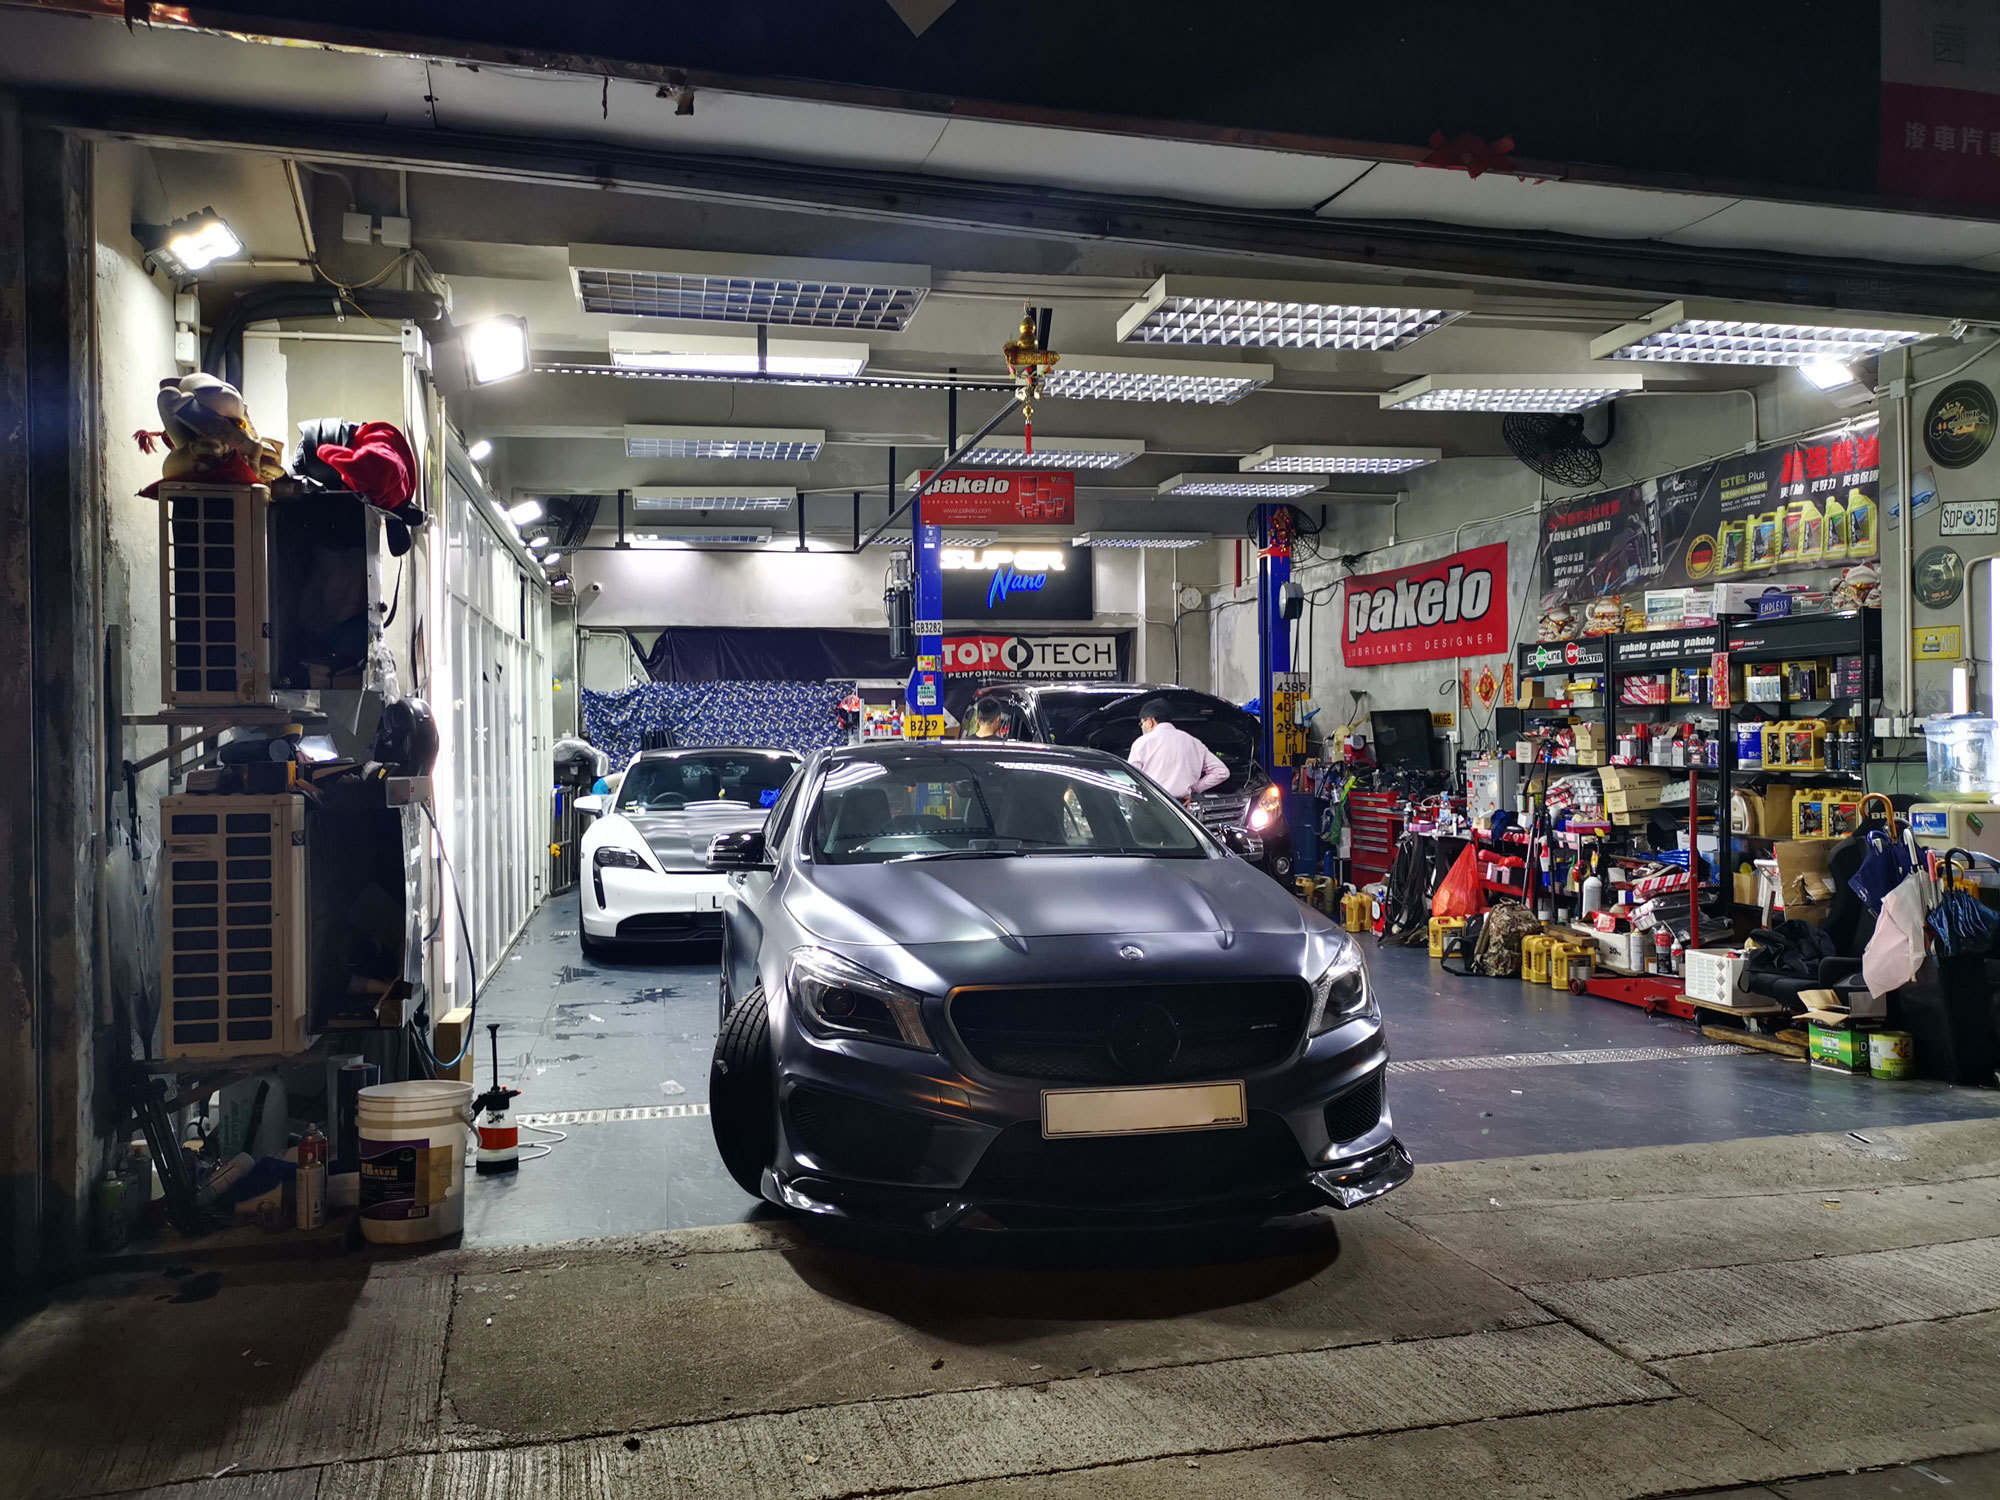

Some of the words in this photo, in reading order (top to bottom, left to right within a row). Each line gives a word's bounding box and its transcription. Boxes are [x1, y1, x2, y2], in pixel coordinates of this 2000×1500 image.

[923, 476, 1010, 496] pakelo
[1748, 471, 1766, 482] Plus
[1943, 509, 1963, 528] SDP
[1976, 508, 1997, 527] 315
[1647, 502, 1659, 563] UPER
[940, 549, 1066, 571] SUPER
[986, 565, 1047, 608] Nano
[1347, 563, 1493, 644] pakelo
[1760, 599, 1788, 614] ENDLESS
[915, 622, 942, 634] GB3282
[1348, 643, 1413, 658] LUBRICANTS
[1424, 632, 1494, 650] DESIGNER
[1619, 642, 1648, 655] pakelo
[1650, 639, 1680, 652] pakelo
[1684, 636, 1716, 649] pakelo
[948, 670, 1023, 679] PERFORMANCE
[1028, 671, 1063, 679] BRAKE
[910, 720, 938, 732] BZ29
[1871, 811, 1907, 820] BRDE
